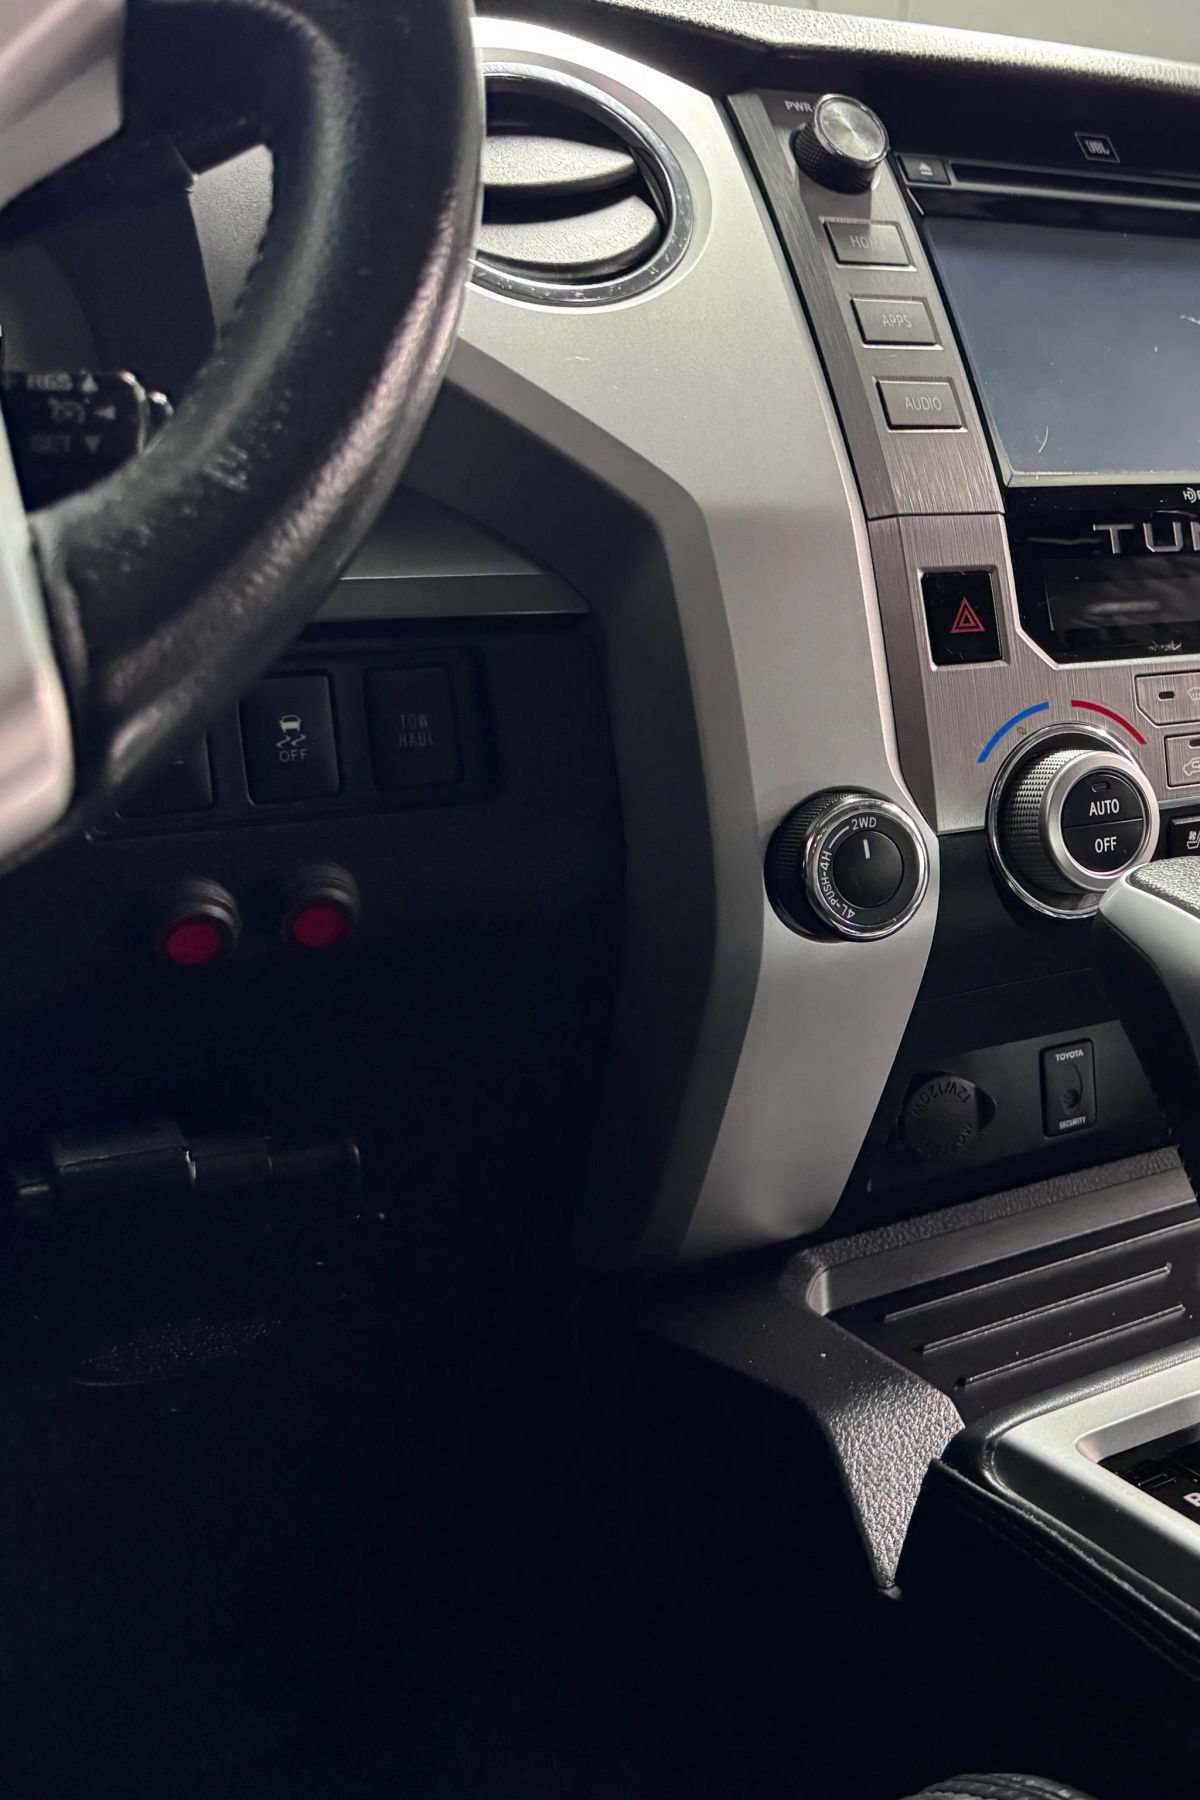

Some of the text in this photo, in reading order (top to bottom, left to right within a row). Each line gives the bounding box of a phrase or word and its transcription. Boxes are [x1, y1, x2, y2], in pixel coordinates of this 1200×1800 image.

[882, 314, 912, 328] APPS
[905, 396, 942, 411] AUDIO
[400, 713, 429, 730] TOW
[279, 748, 308, 763] OFF
[1089, 798, 1120, 816] AUTO
[851, 816, 877, 831] 2WD
[1094, 836, 1117, 853] OFF
[1055, 1049, 1084, 1062] TOYOTA
